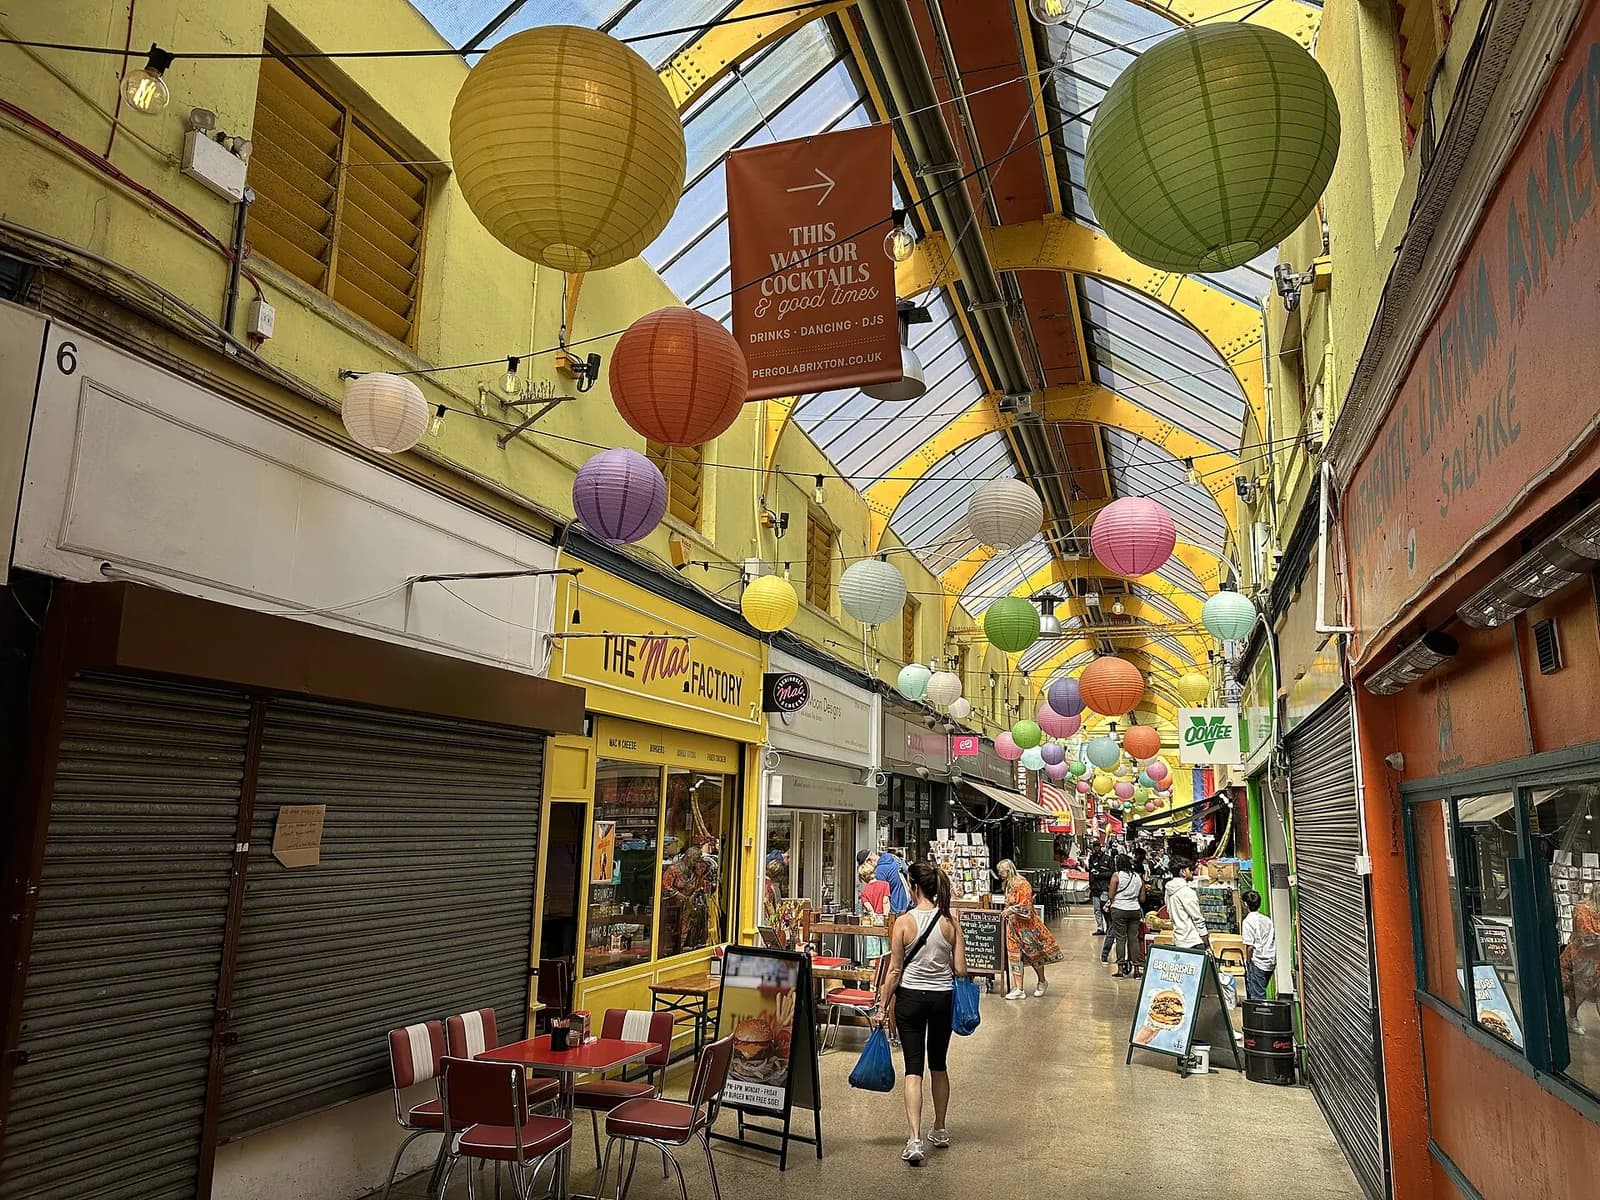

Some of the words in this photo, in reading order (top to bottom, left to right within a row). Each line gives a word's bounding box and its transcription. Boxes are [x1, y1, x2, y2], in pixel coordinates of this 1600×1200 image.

[788, 222, 836, 246] THIS
[769, 247, 813, 273] WAY
[817, 242, 858, 266] FOR
[760, 262, 870, 297] COCKTAILS
[754, 298, 772, 318] &
[777, 278, 830, 320] good
[830, 284, 880, 305] times
[750, 328, 791, 343] DRINKS
[800, 320, 852, 336] DANCING
[862, 315, 885, 327] DJS
[57, 341, 78, 375] 6
[752, 352, 882, 379] PERGOLABRIXTON.CO.UK
[602, 630, 637, 678] THE
[639, 630, 690, 685] Mac
[691, 661, 742, 707] FACTORY
[776, 685, 805, 702] Mac
